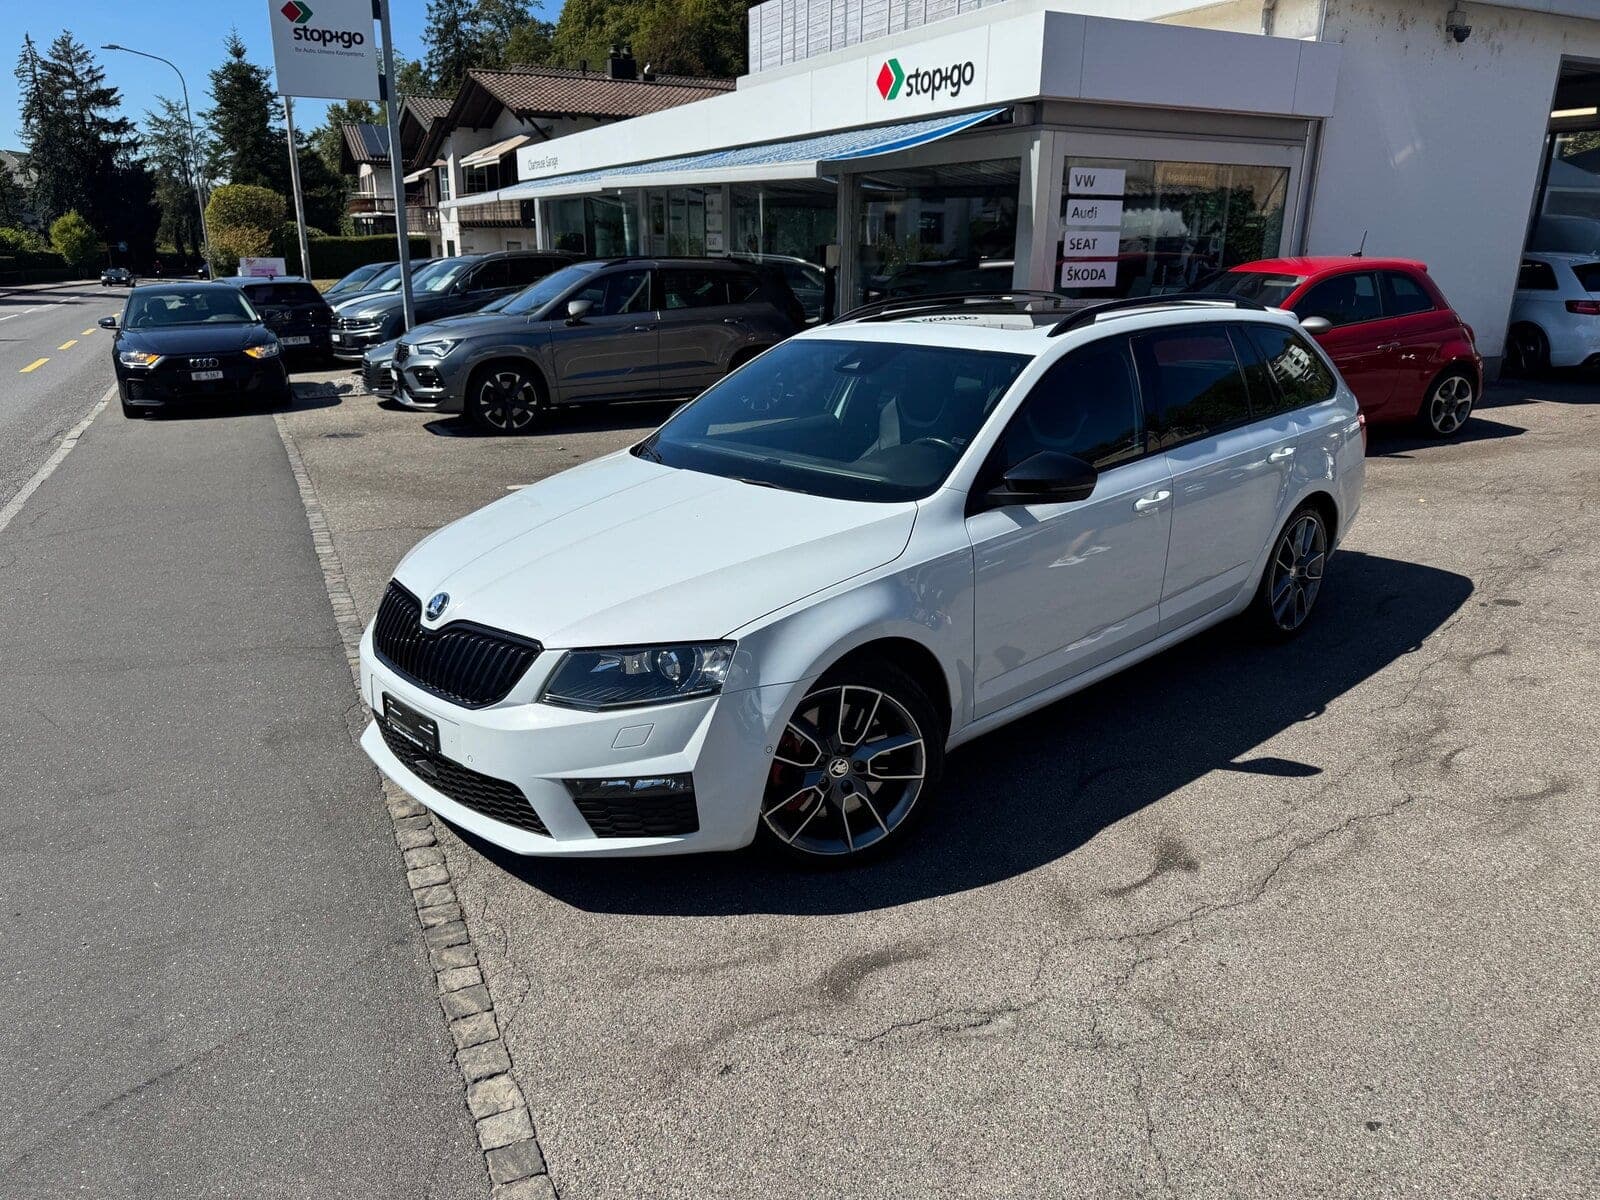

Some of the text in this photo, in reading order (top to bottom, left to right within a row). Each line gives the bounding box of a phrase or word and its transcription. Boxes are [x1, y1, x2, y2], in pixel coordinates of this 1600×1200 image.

[293, 25, 364, 48] stop+go
[906, 61, 975, 101] stop+go
[1075, 174, 1096, 187] VW
[1071, 206, 1098, 219] Audi
[1069, 238, 1098, 250] SEAT
[1067, 266, 1106, 281] ŠKODA
